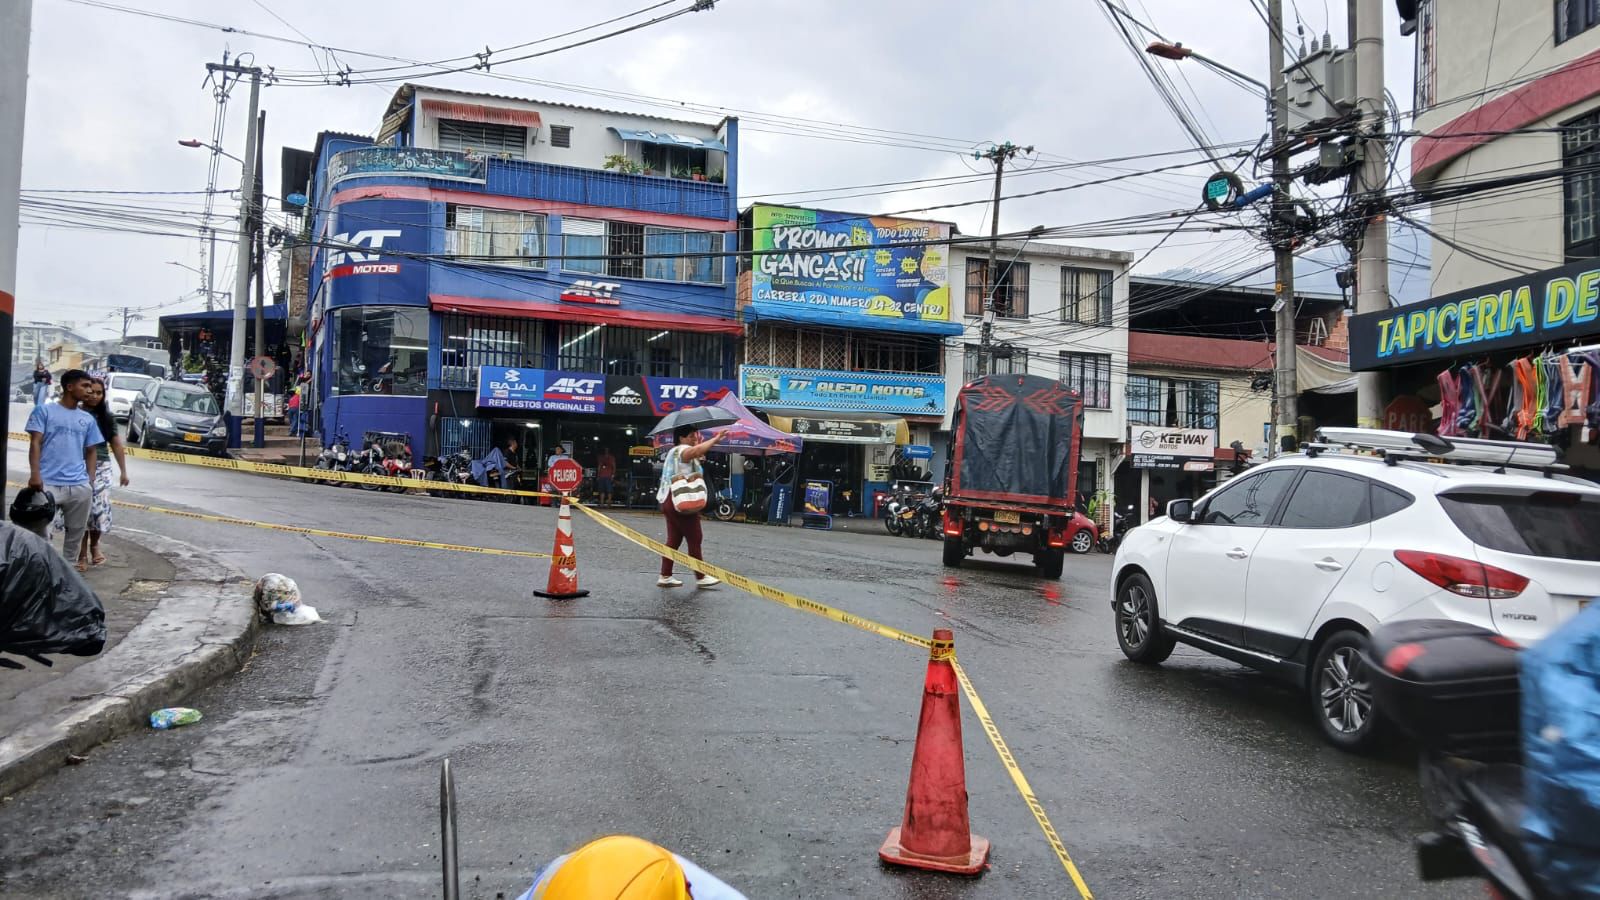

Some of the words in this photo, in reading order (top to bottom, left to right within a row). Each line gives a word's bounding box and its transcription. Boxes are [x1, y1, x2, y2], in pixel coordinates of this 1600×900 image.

[772, 224, 849, 256] PROMO
[876, 227, 897, 239] TODO
[898, 228, 910, 238] LO
[911, 227, 929, 238] QUE
[352, 264, 398, 274] MOTOS
[560, 280, 621, 298] AKT
[780, 278, 794, 286] Que
[757, 290, 807, 304] CARRERA
[809, 294, 828, 306] 2DA
[830, 295, 872, 310] NUMERO
[903, 303, 943, 316] CENTRO
[1377, 285, 1536, 358] TAPICERIA
[489, 381, 537, 392] BAJAJ
[546, 378, 603, 394] AKT
[660, 384, 699, 398] TVS
[816, 381, 867, 394] ALEJO
[872, 384, 925, 398] MOTOS
[488, 398, 542, 409] REPUESTOS
[543, 402, 596, 413] ORIGINALES
[609, 393, 643, 406] auteco
[1160, 432, 1208, 446] KEEWAY
[553, 469, 577, 483] PELIGRO
